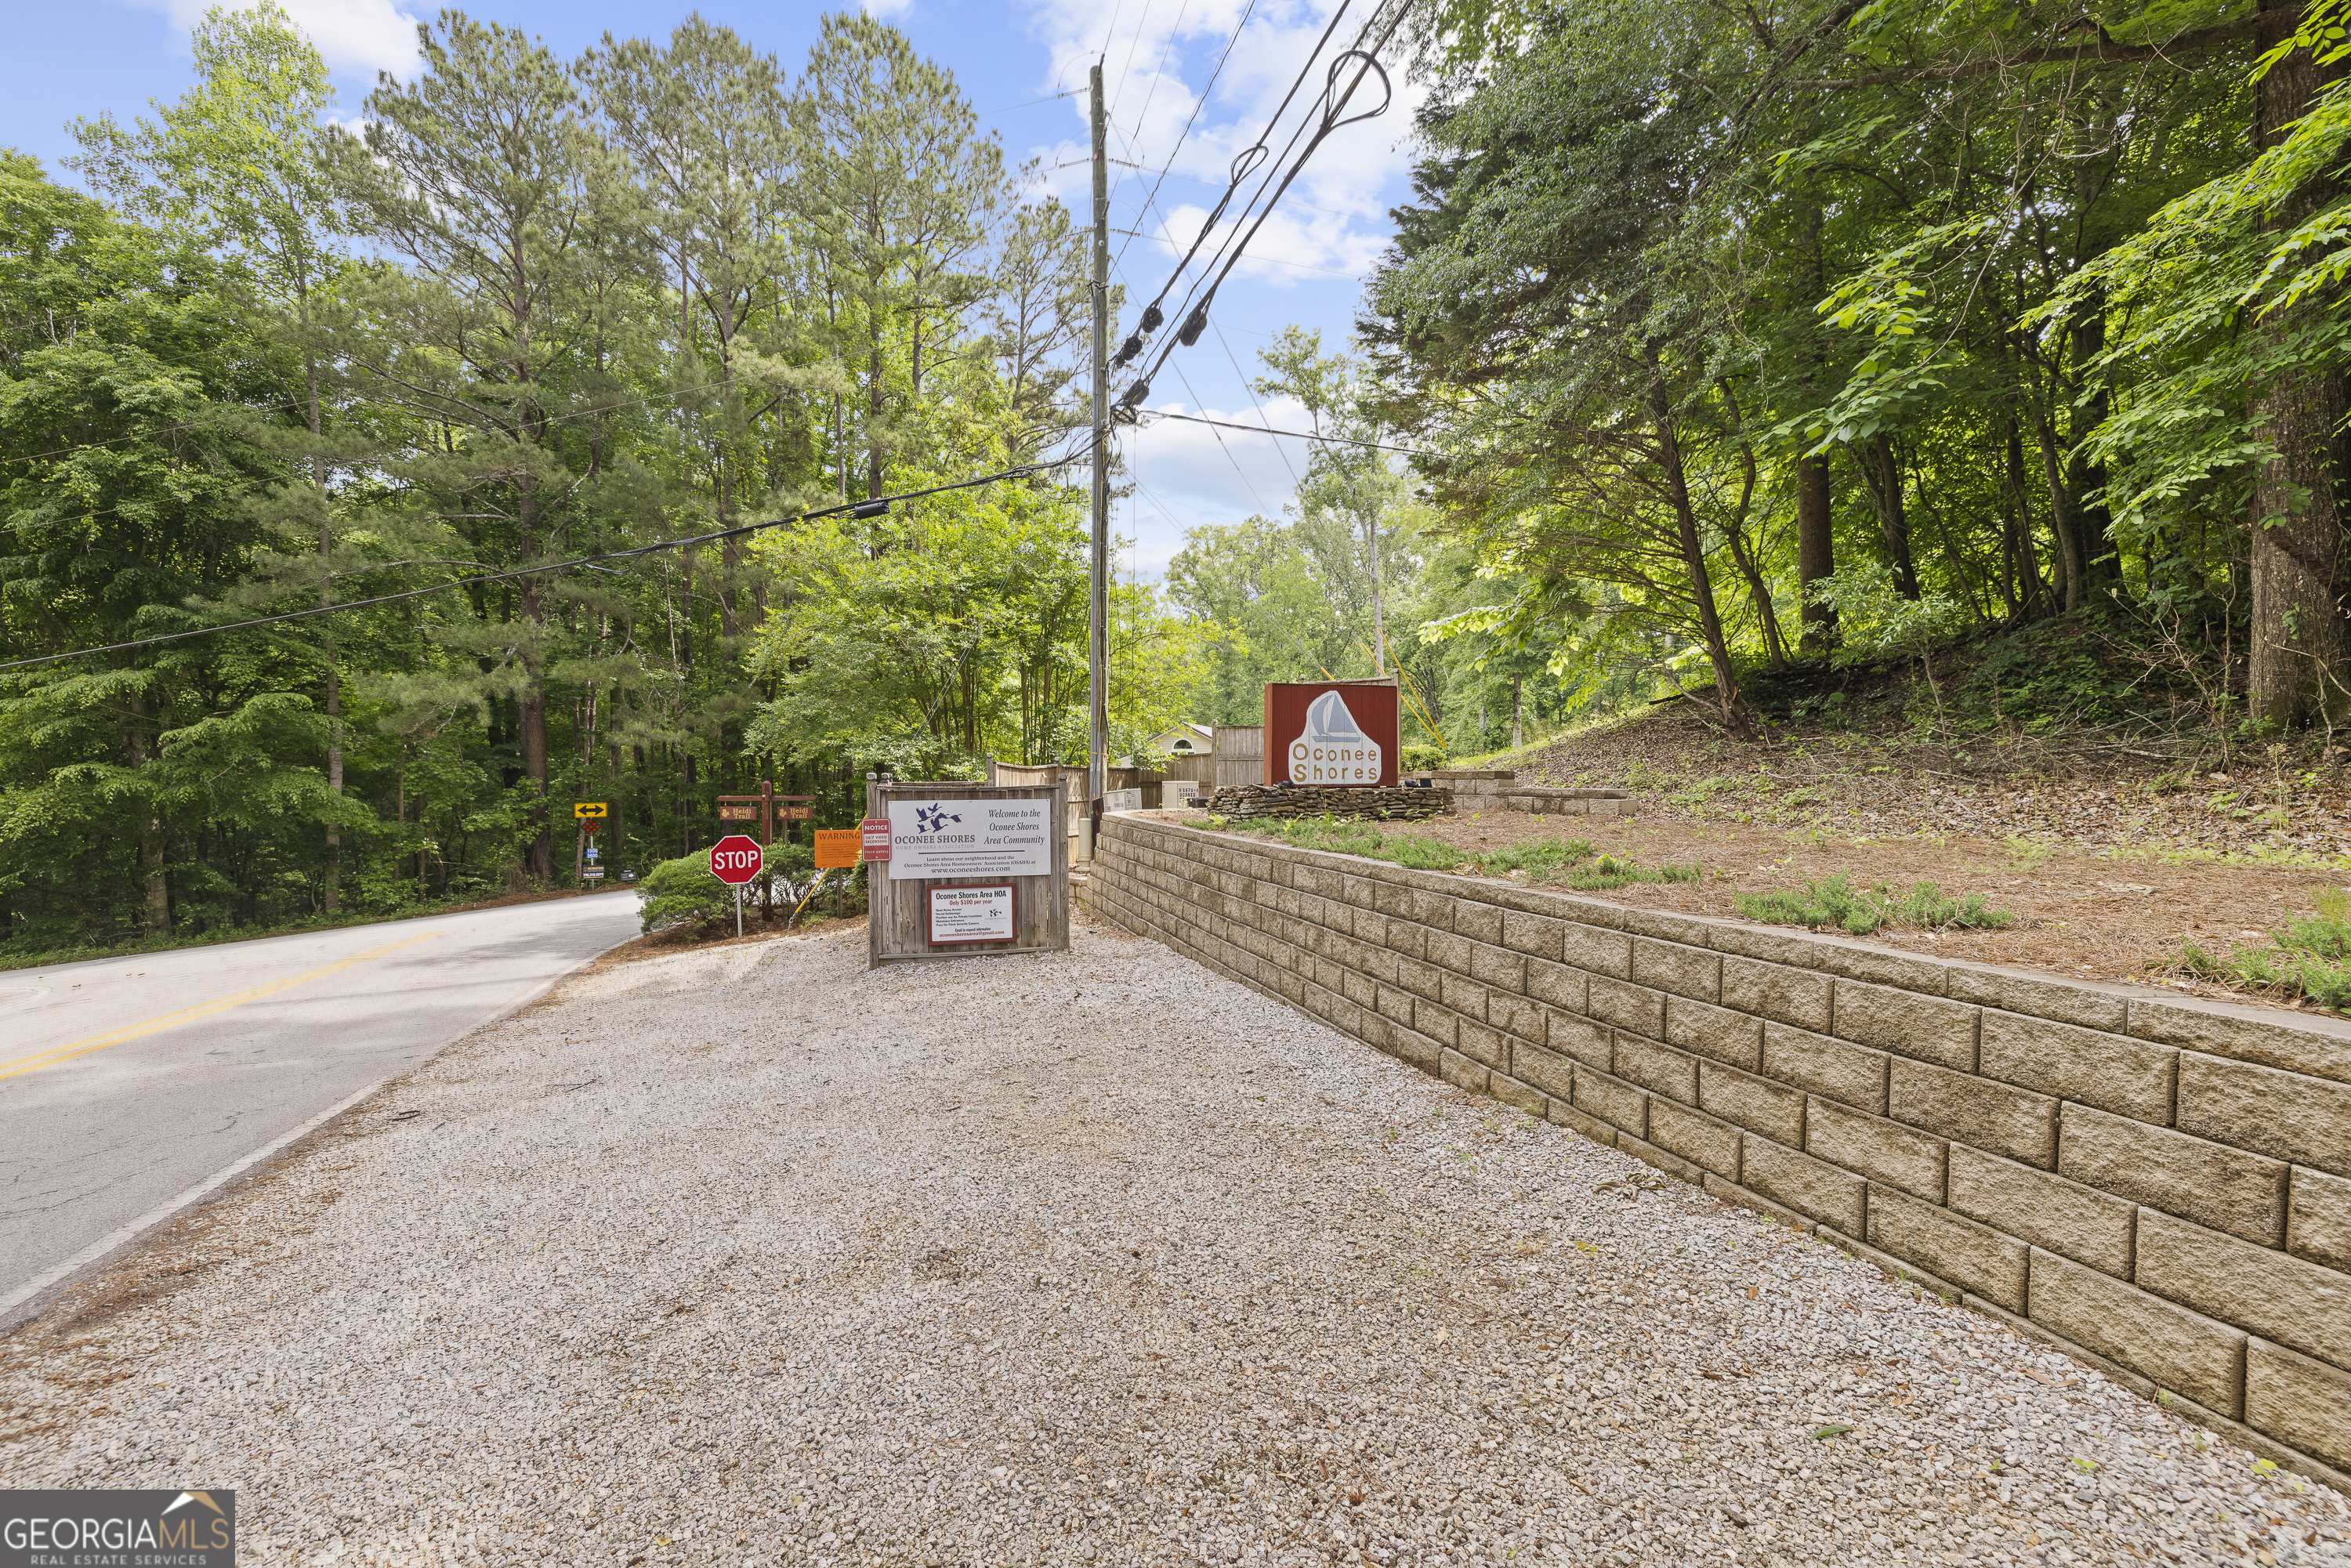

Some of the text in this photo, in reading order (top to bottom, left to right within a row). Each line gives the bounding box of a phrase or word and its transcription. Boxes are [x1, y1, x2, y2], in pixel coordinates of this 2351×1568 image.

[1292, 743, 1377, 762] Oconee
[1294, 763, 1378, 782] Shores
[988, 809, 1020, 818] Welcome
[1030, 809, 1041, 817] the
[989, 822, 1040, 831] Oconee Shores
[818, 832, 860, 840] WARNING
[895, 835, 975, 844] OCONEE SHORES
[984, 835, 1045, 846] Area Community
[714, 850, 759, 870] STOP
